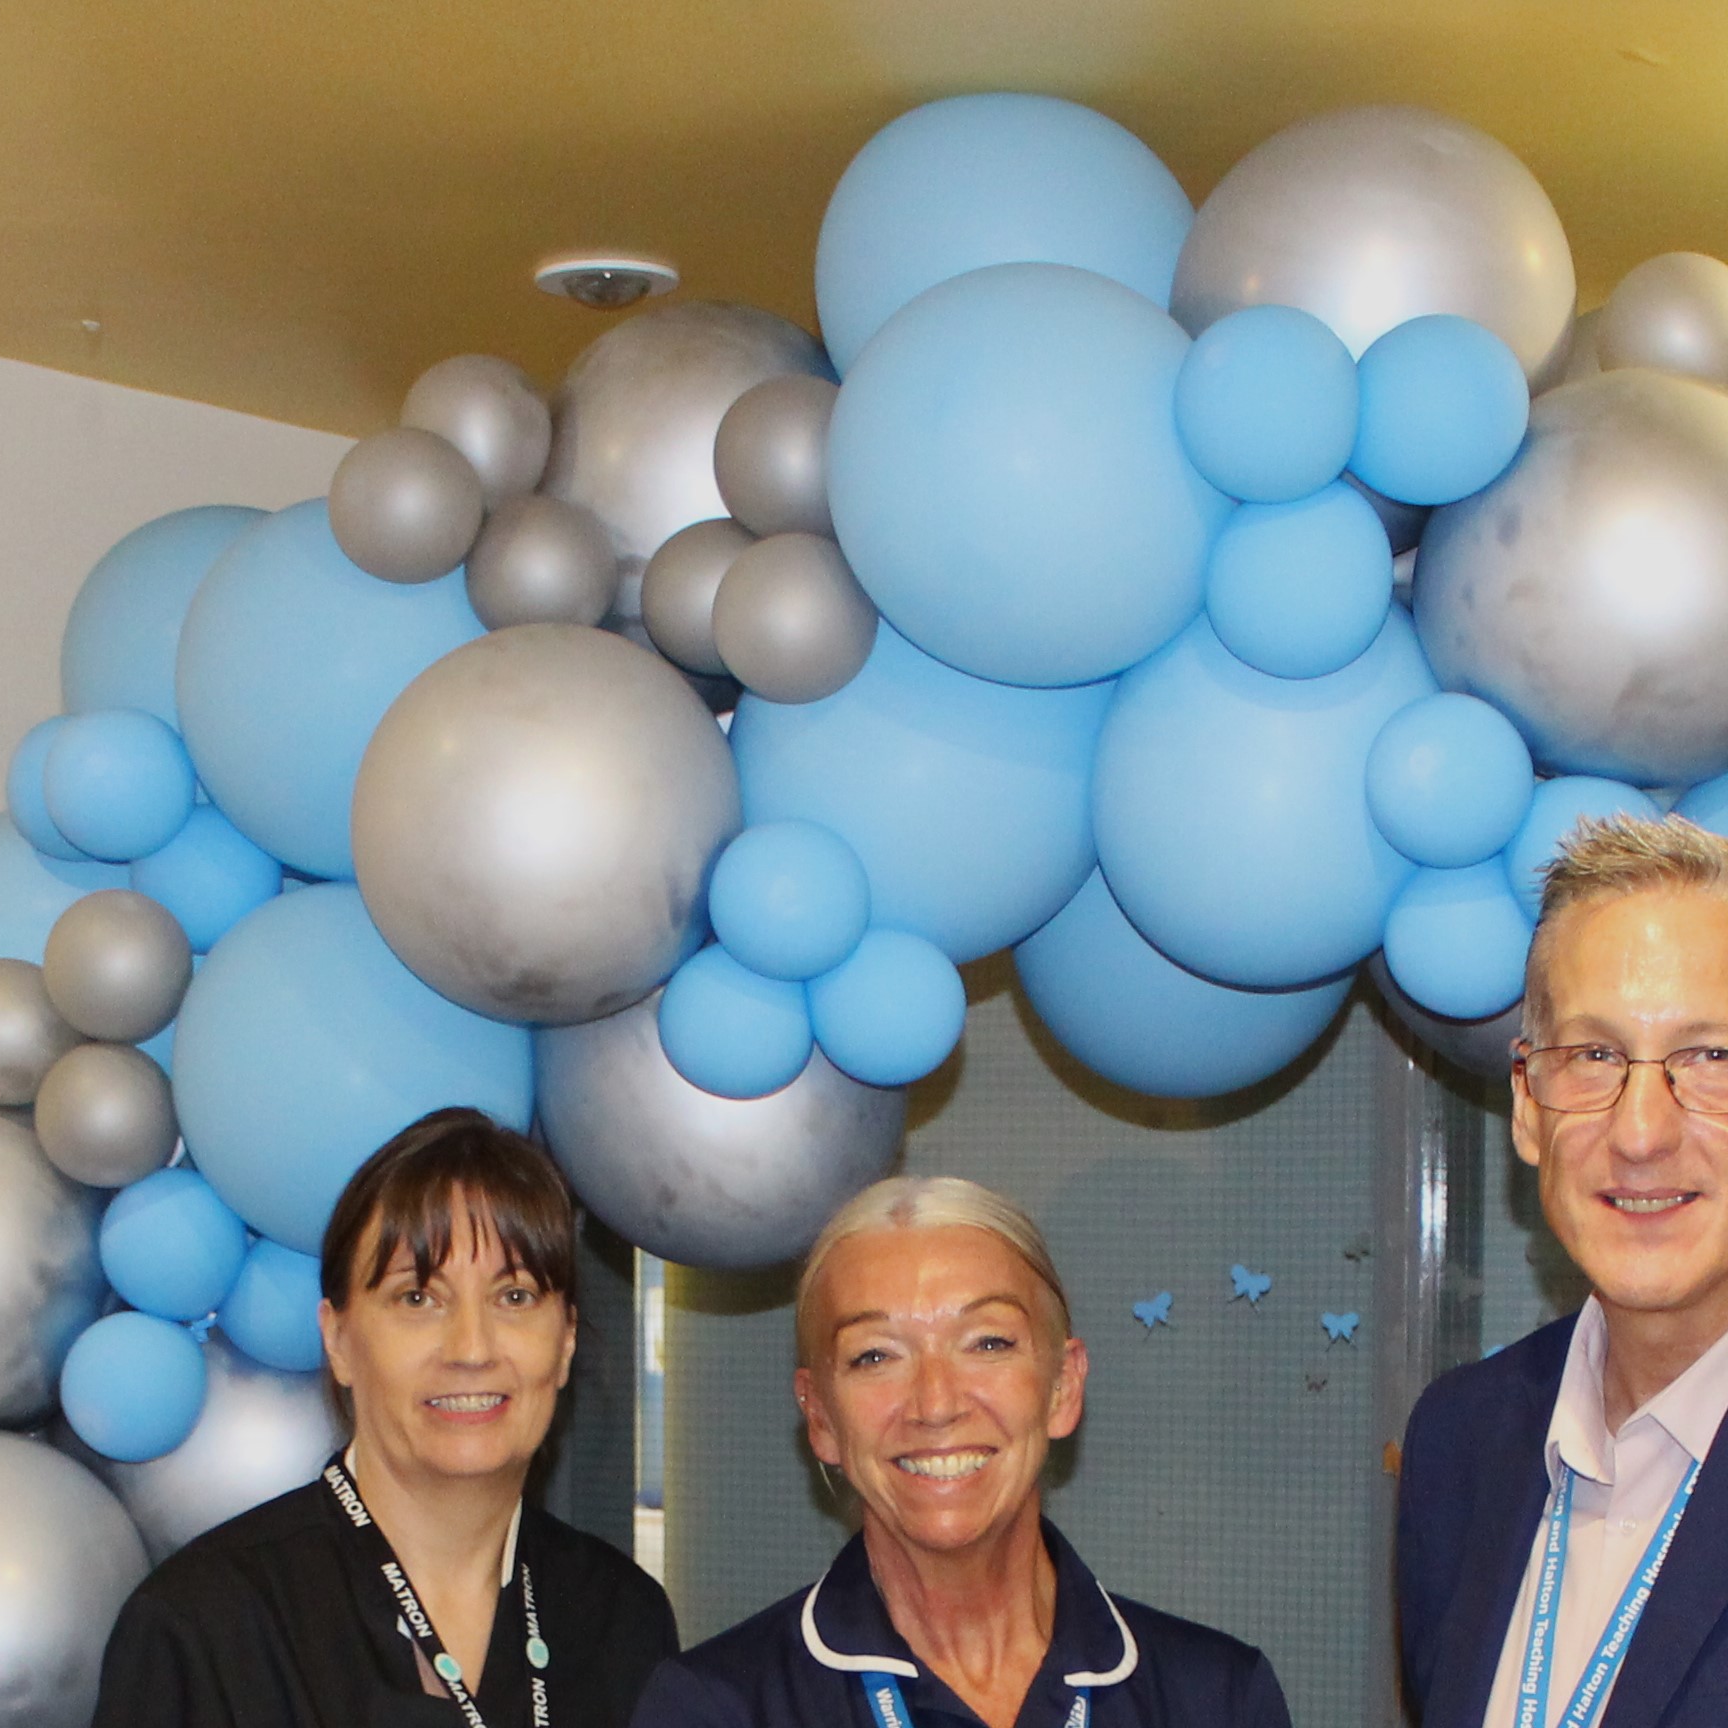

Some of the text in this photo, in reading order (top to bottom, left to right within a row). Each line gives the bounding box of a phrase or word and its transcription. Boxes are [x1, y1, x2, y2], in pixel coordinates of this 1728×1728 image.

[324, 1464, 371, 1528] MATRON
[1549, 1521, 1561, 1553] and
[380, 1561, 433, 1639] MATRON
[521, 1563, 541, 1639] MATRON
[1538, 1555, 1558, 1615] Halton
[1523, 1618, 1549, 1694] Teaching
[1573, 1662, 1608, 1720] Halton
[1601, 1587, 1651, 1659] Teaching
